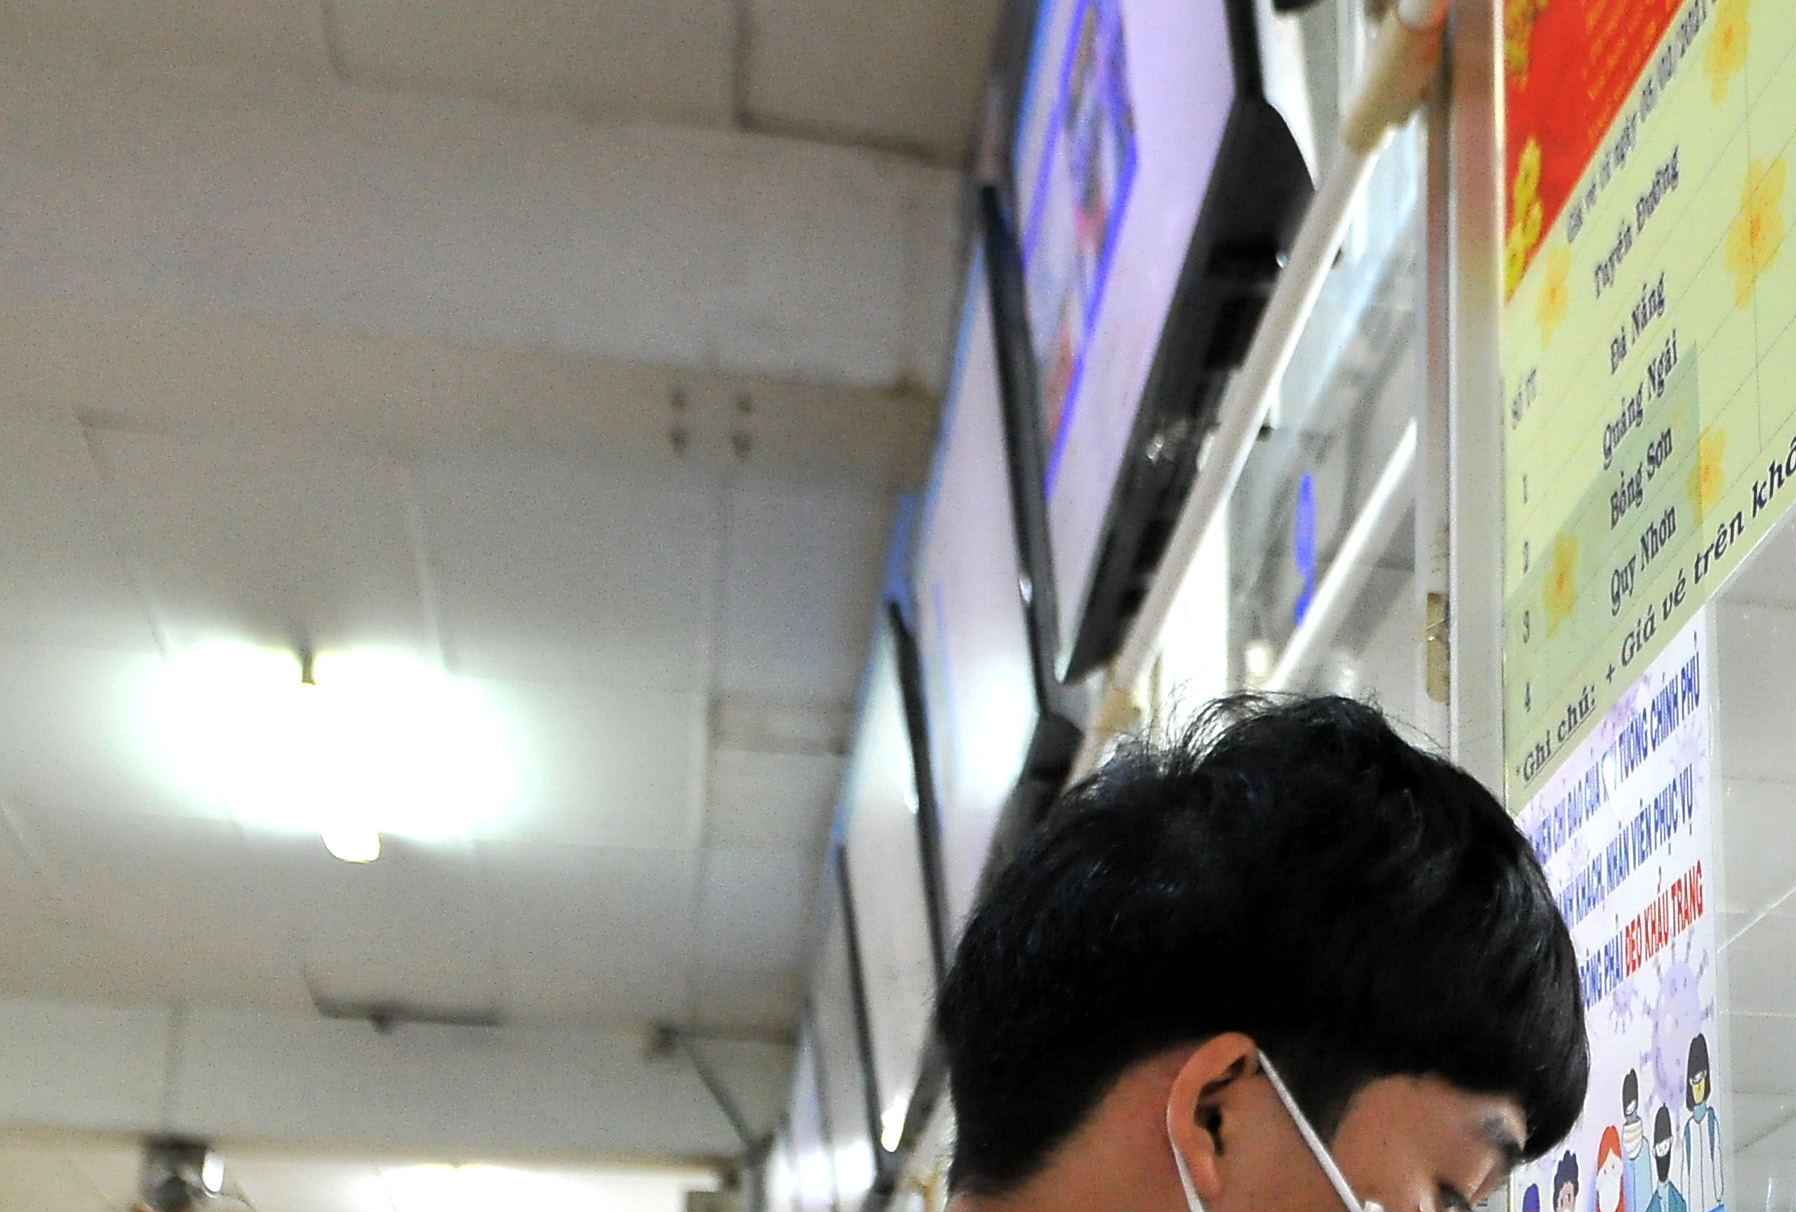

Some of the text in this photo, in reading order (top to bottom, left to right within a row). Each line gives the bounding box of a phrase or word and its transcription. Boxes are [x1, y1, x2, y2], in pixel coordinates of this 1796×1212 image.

[1610, 554, 1637, 617] Quy
[1639, 505, 1677, 572] Nhơn
[1556, 684, 1597, 744] chú:
[1620, 603, 1657, 668] Giá
[1661, 567, 1687, 621] vé
[1693, 510, 1745, 585] trên
[1650, 671, 1680, 752] CHÍNH
[1681, 630, 1700, 721] PHỦ
[1630, 797, 1652, 872] VIÊN
[1653, 776, 1679, 857] PHỤC
[1680, 762, 1694, 836] VỤ
[1625, 913, 1643, 979] ĐEO
[1644, 866, 1669, 962] KHẨU
[1671, 859, 1704, 938] TRANG
